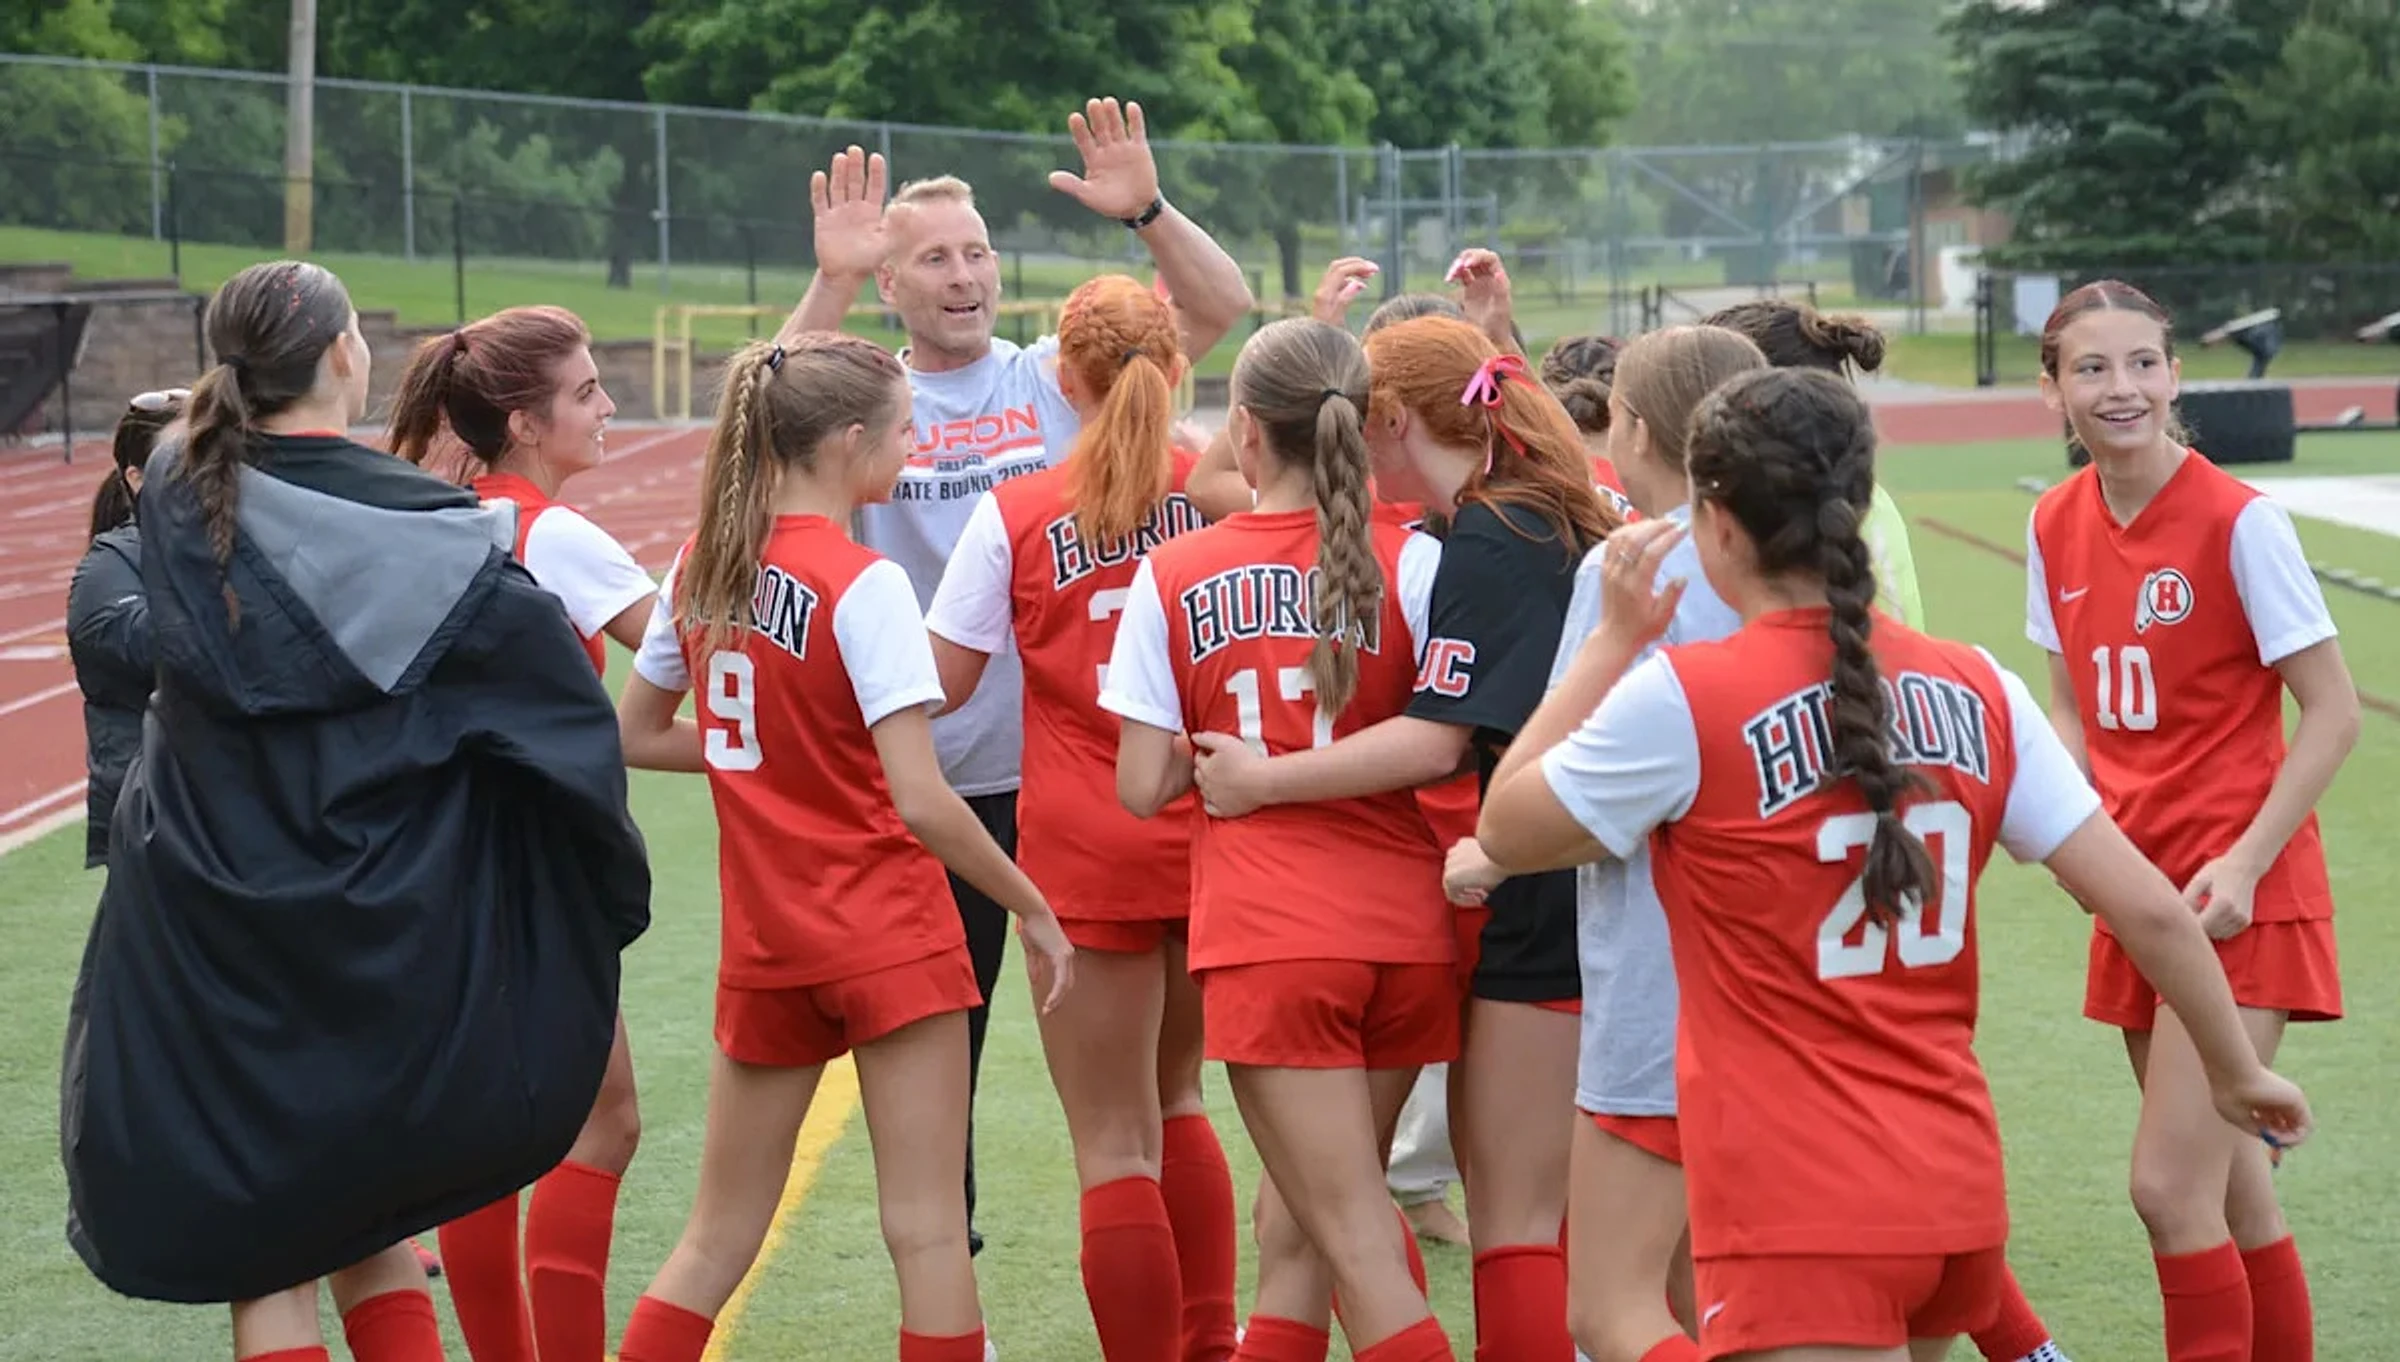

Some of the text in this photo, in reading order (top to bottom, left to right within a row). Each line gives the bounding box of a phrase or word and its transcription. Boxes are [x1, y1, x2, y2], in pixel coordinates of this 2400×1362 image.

[911, 404, 1038, 451] URON
[2156, 581, 2181, 612] H
[704, 650, 763, 771] 9
[2092, 645, 2158, 731] 10
[1817, 800, 1971, 981] 20
